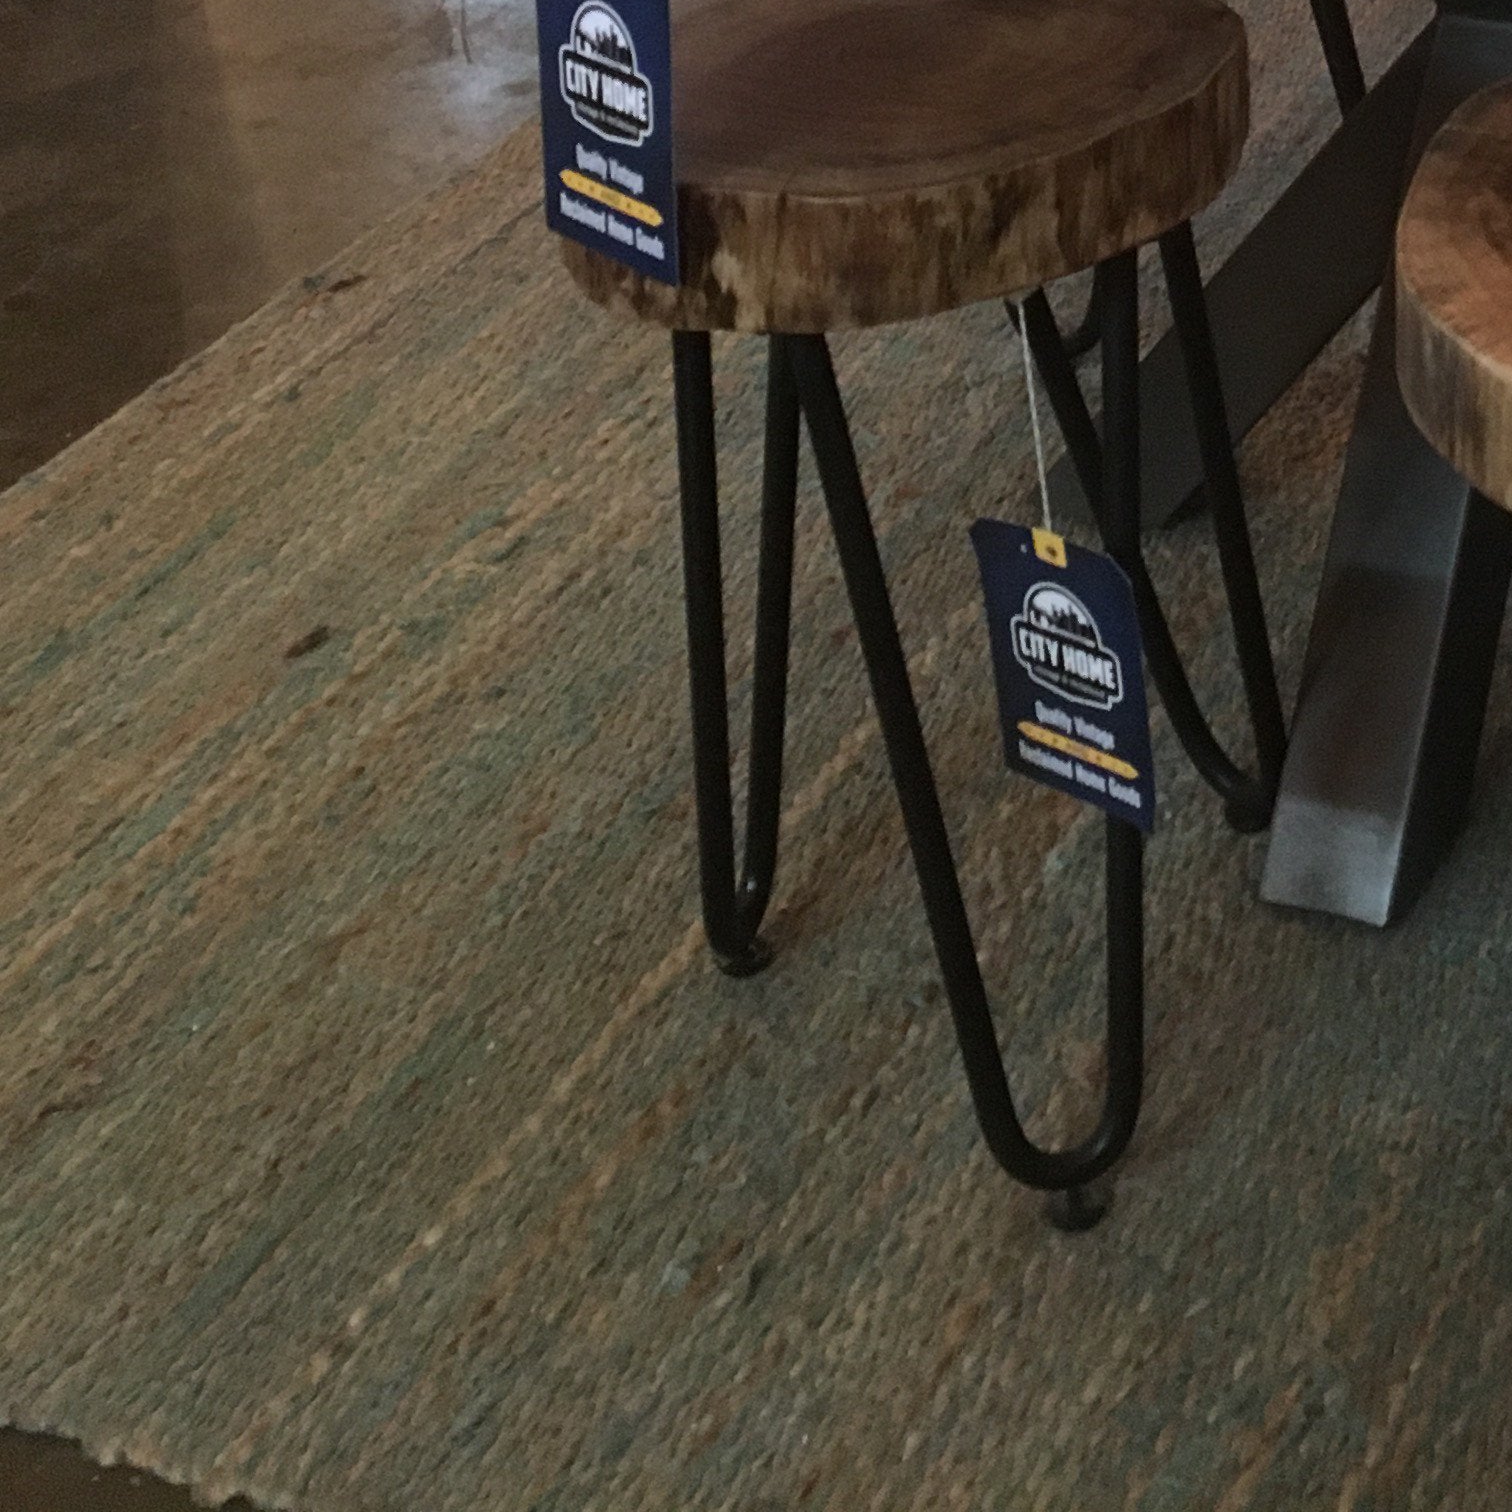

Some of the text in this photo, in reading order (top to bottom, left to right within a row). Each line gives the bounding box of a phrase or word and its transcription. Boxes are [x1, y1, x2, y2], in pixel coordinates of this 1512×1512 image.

[565, 58, 599, 101] CITY
[601, 73, 648, 122] HOME
[1018, 627, 1060, 667] CITY
[1062, 642, 1117, 689] HOME
